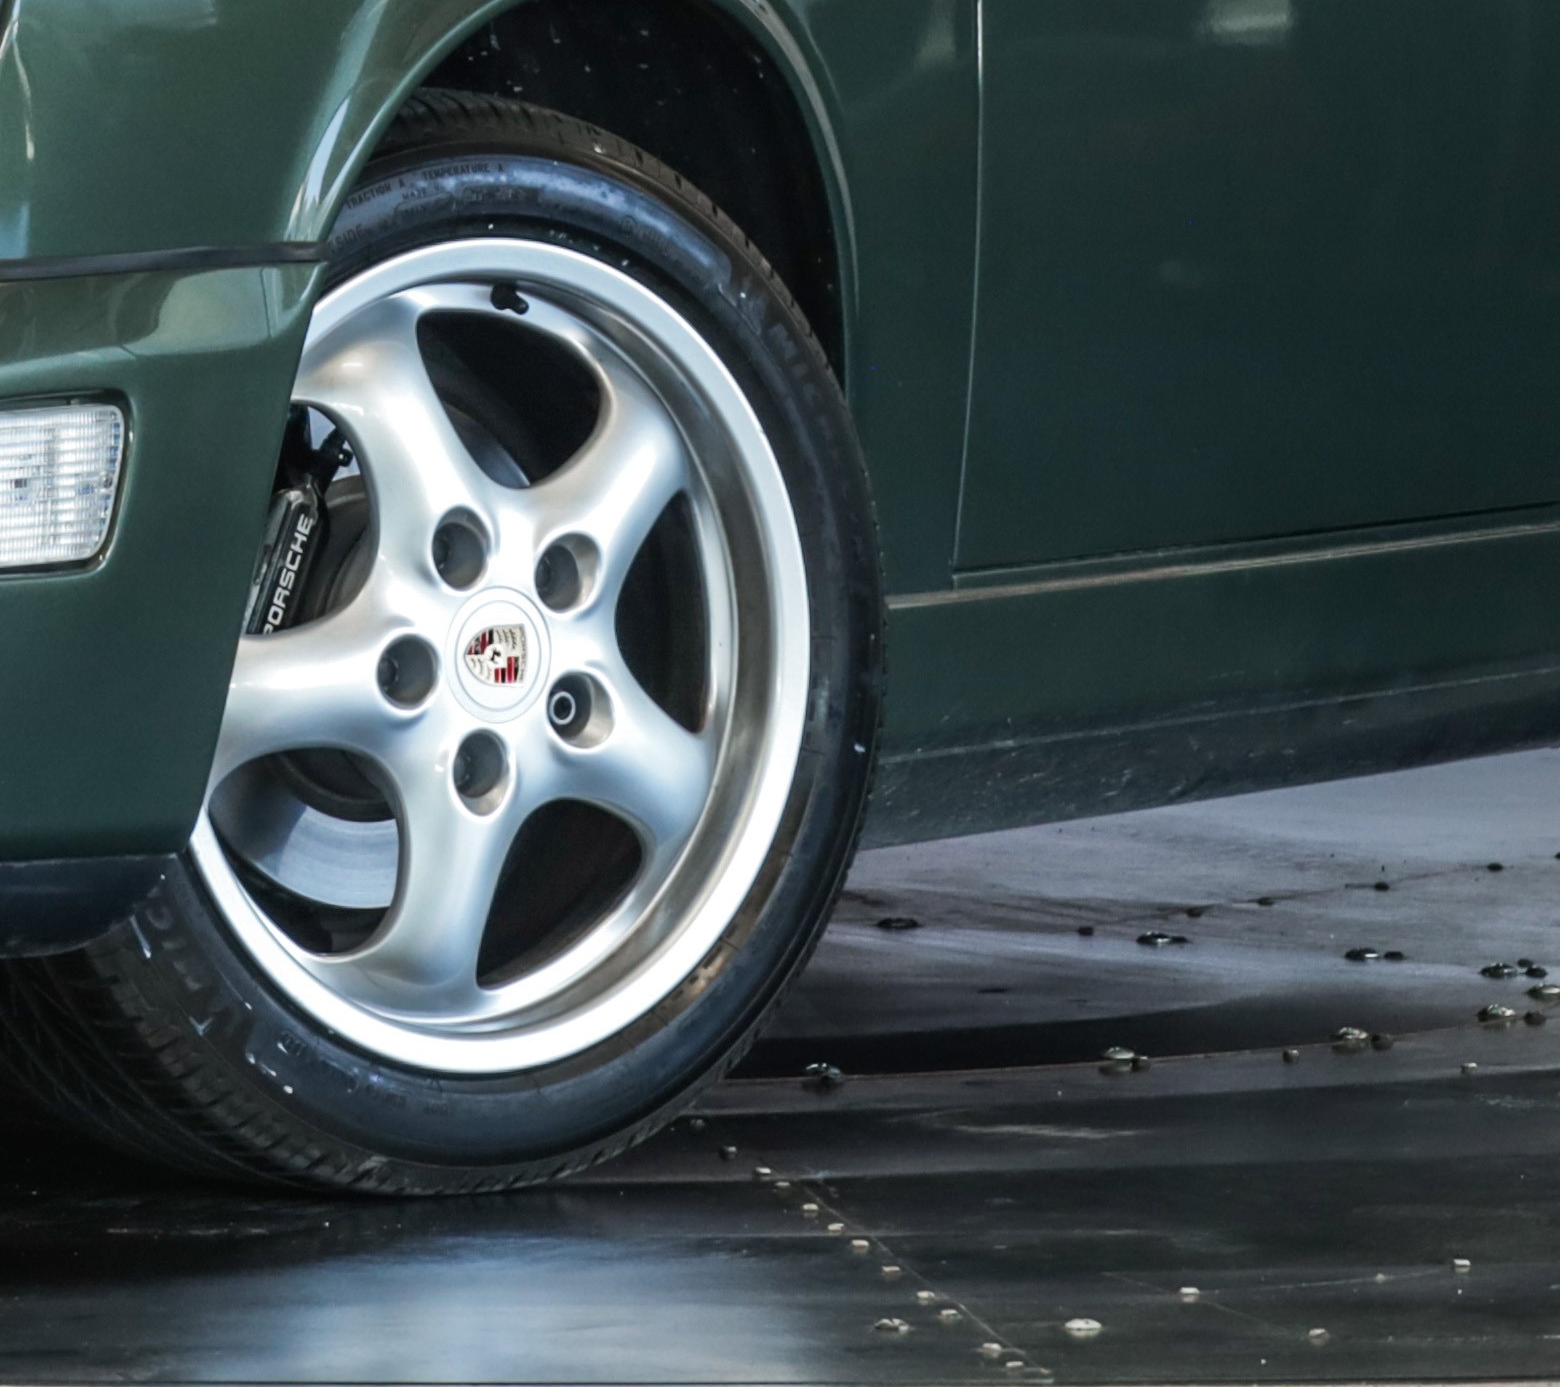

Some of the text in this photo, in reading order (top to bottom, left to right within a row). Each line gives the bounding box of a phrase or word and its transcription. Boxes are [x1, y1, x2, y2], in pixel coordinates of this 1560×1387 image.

[346, 182, 392, 209] TRACTION
[422, 162, 490, 181] TEMPERATURE
[263, 513, 314, 635] PORSCHE
